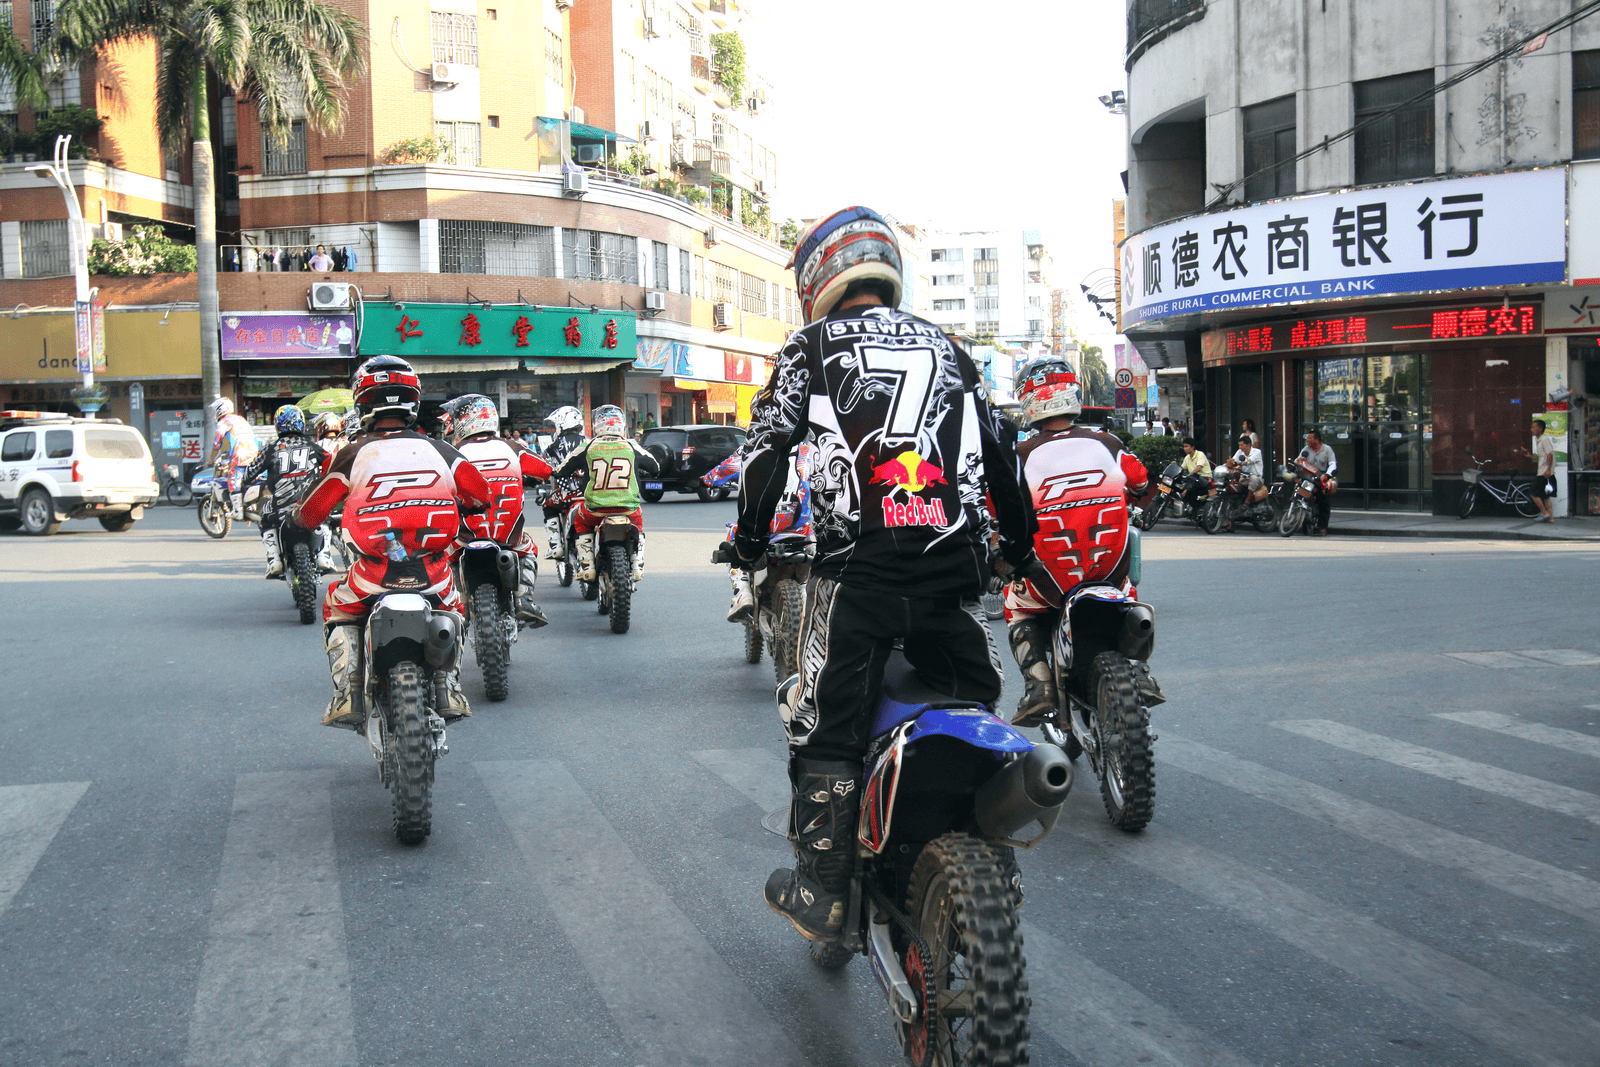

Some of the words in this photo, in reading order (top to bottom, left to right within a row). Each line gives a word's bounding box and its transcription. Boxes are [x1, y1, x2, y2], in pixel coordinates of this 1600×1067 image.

[1142, 192, 1484, 297] 顺德农商银行
[1139, 303, 1169, 319] SHUNDE
[1171, 297, 1207, 311] RURAL
[1211, 285, 1312, 305] COMMERCIAL
[1321, 279, 1375, 294] BANK
[235, 328, 319, 344] 存金日杂店
[396, 313, 619, 350] 仁康堂药店
[831, 320, 938, 338] STEWART
[1119, 373, 1130, 383] 30
[858, 345, 937, 438] 7
[182, 440, 201, 459] 送
[278, 447, 309, 472] 14
[592, 457, 632, 490] 12
[357, 499, 455, 516] PROGRIP
[1036, 496, 1121, 515] PROGRIP
